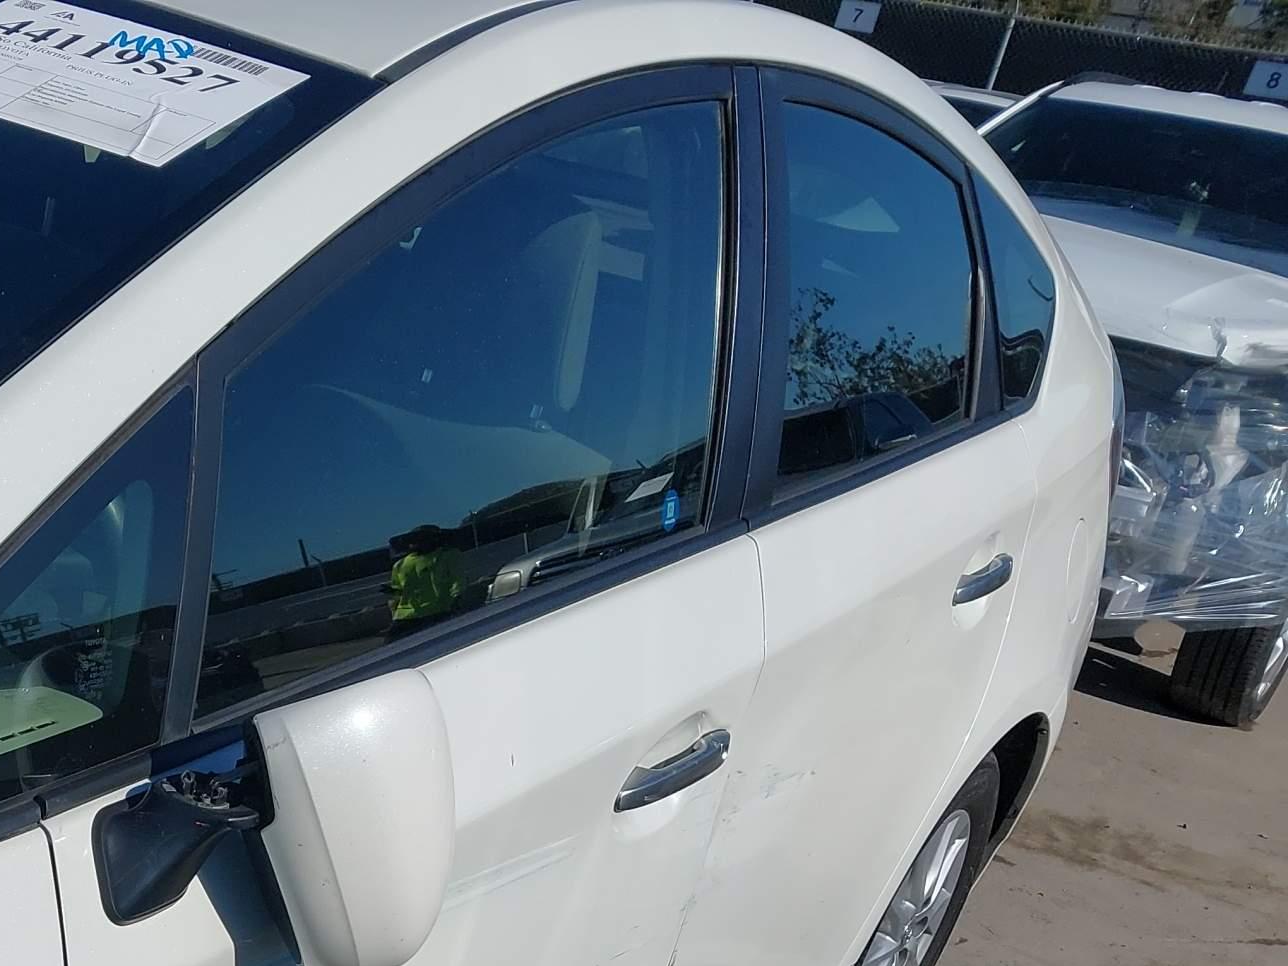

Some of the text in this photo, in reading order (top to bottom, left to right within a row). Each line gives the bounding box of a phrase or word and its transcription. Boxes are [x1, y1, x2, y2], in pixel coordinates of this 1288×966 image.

[852, 7, 864, 23] 7
[12, 40, 73, 62] California
[1266, 71, 1282, 89] 8
